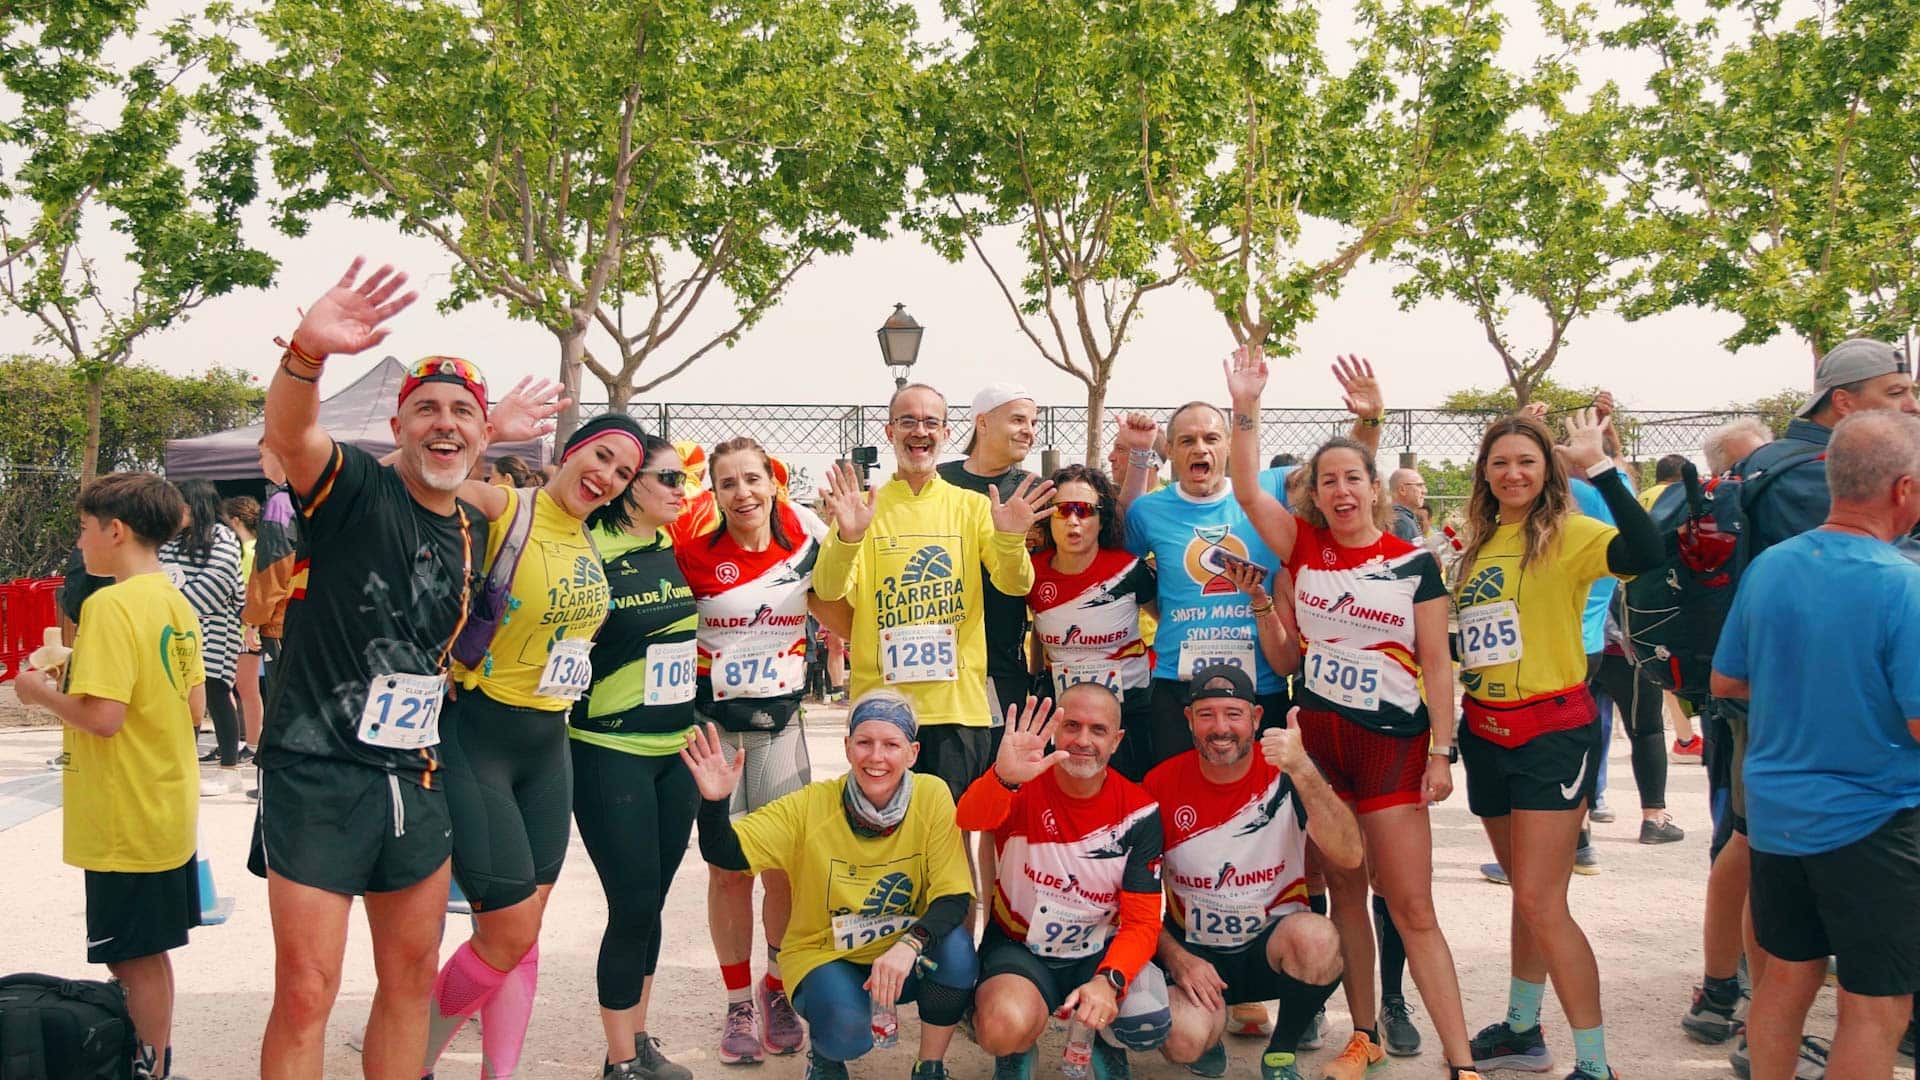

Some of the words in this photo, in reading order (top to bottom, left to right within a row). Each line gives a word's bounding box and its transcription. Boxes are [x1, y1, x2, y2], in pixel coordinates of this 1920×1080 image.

[885, 578, 964, 610] CARRERA
[877, 596, 964, 631] SOLIDARIA
[1459, 619, 1516, 654] 1265
[550, 654, 590, 687] 1308
[887, 642, 953, 668] 1285
[725, 657, 778, 687] 874
[1311, 654, 1378, 693] 1305
[1192, 907, 1263, 934] 1282
